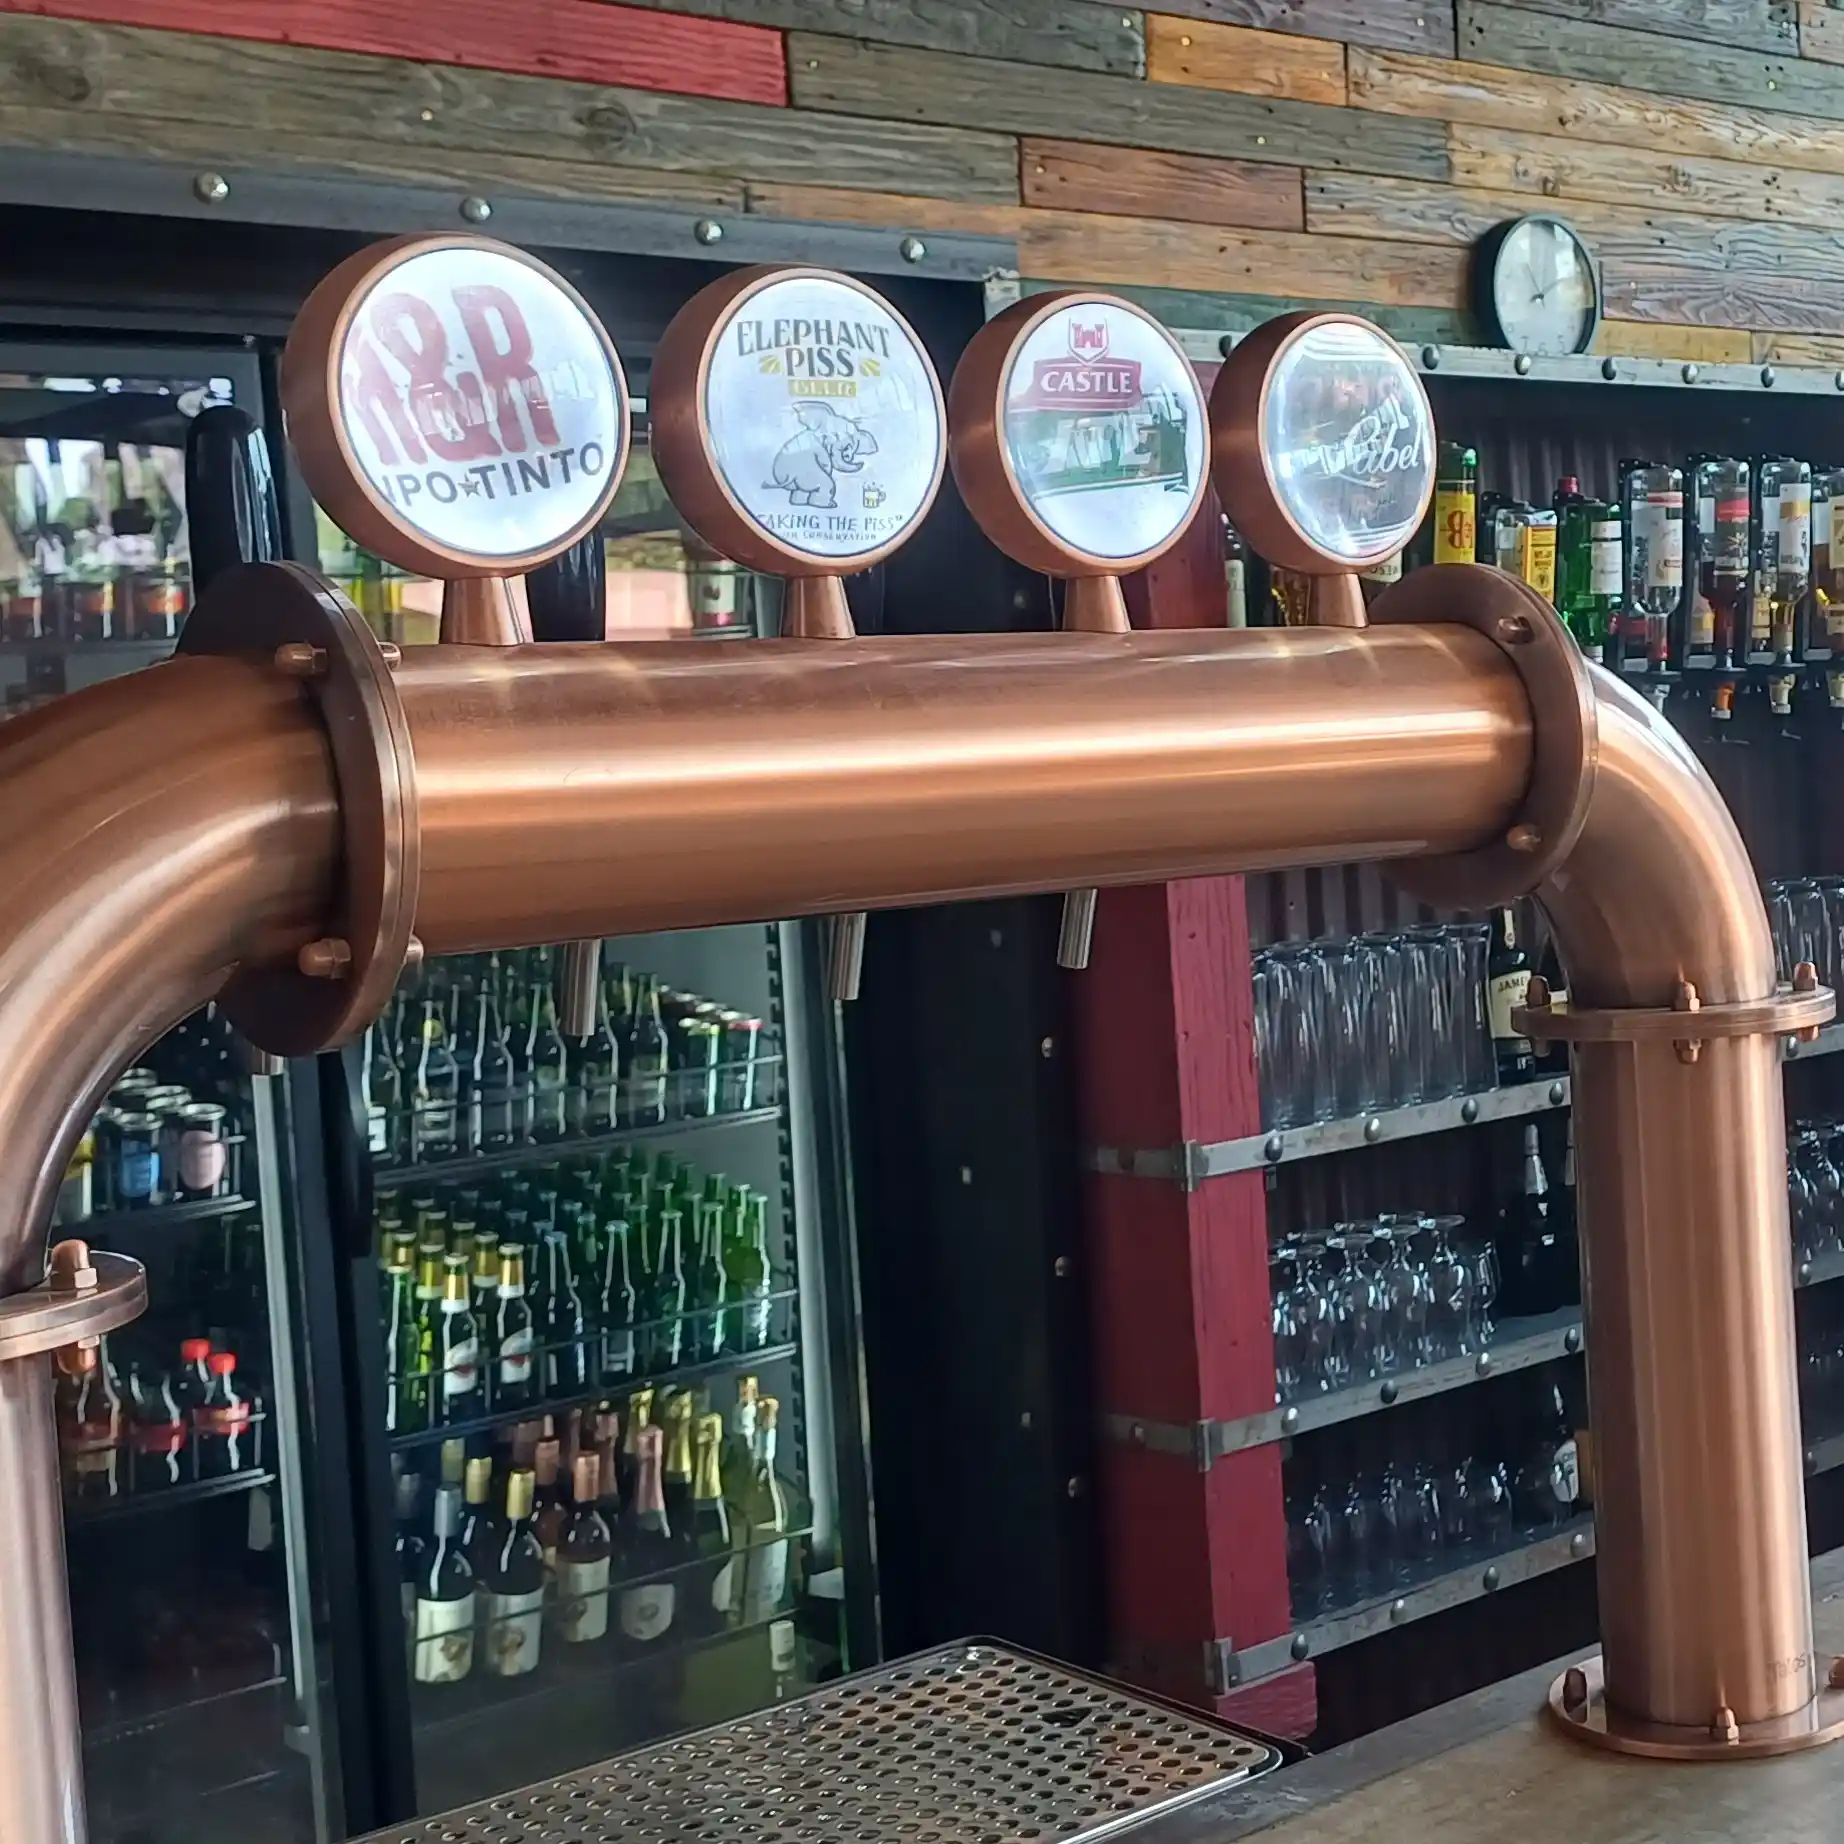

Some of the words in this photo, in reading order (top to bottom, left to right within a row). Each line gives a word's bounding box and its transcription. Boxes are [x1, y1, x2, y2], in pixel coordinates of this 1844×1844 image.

[735, 318, 891, 358] ELEPHANT
[785, 346, 855, 378] PISS
[1040, 371, 1133, 393] CASTLE
[468, 441, 604, 500] TINTO
[825, 515, 858, 531] THE
[1497, 975, 1528, 994] JAME
